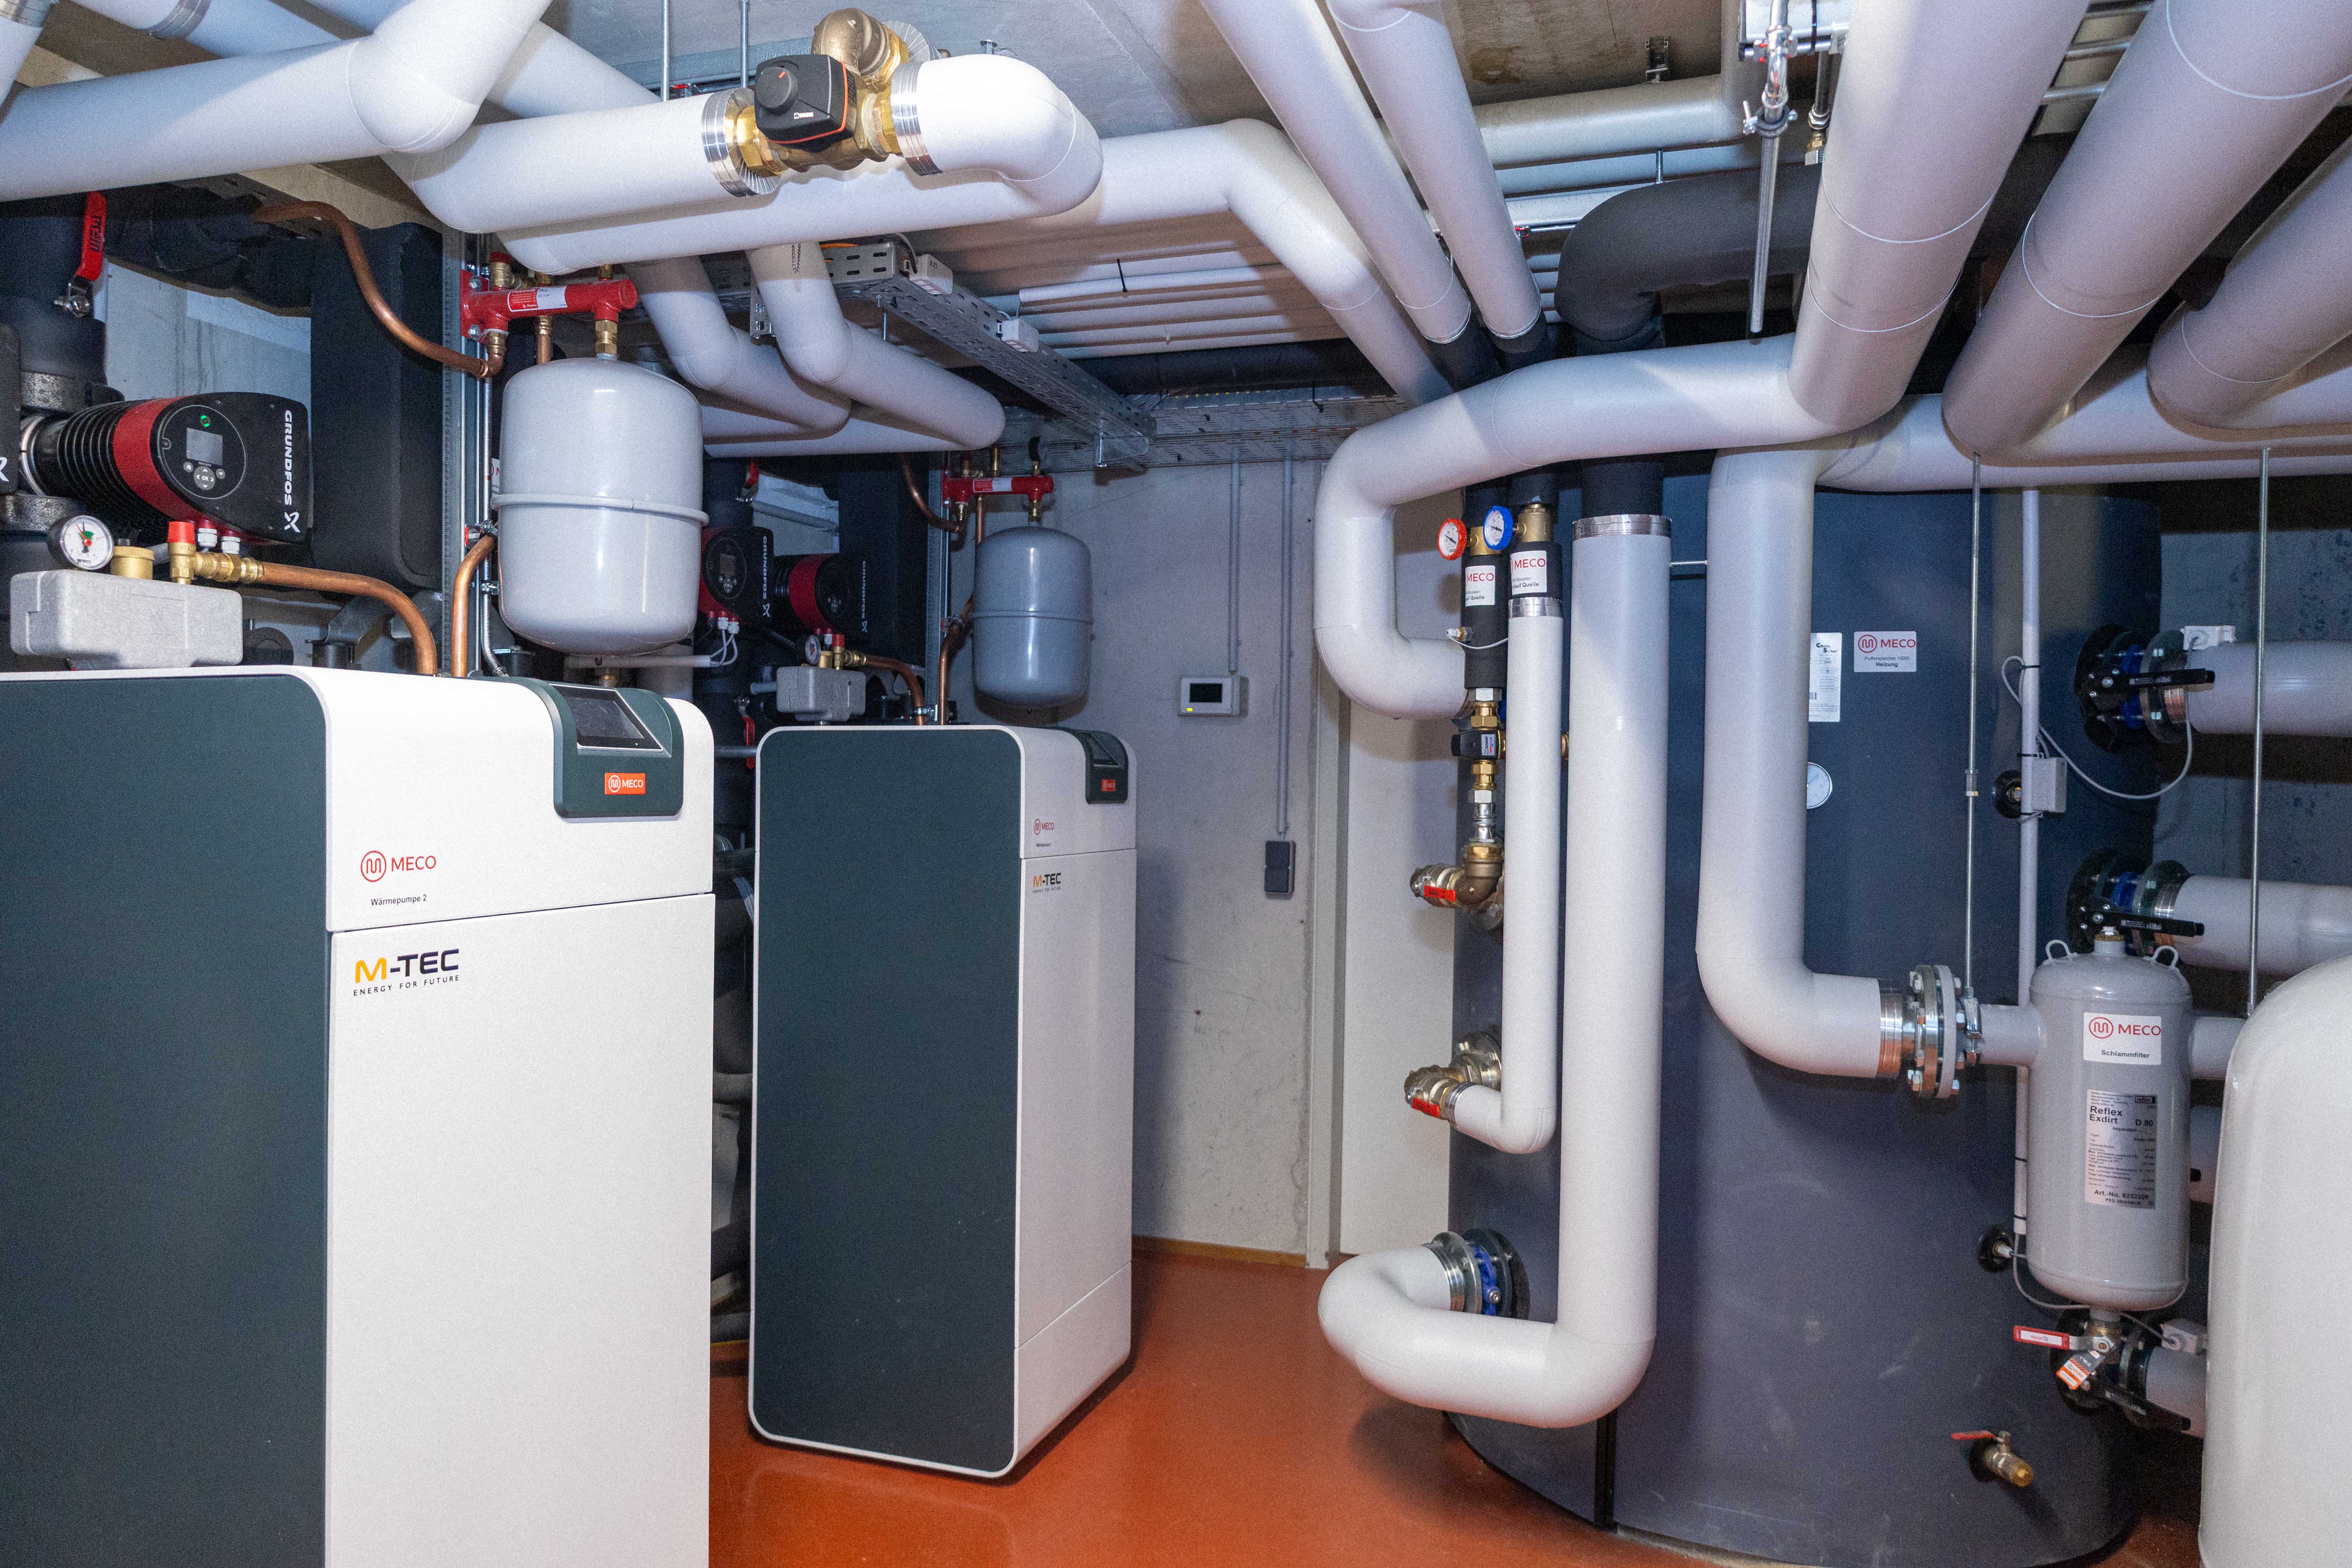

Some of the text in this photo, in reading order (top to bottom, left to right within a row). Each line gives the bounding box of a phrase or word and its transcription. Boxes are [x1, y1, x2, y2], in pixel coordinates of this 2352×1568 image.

[1514, 558, 1546, 569] MECO
[1467, 573, 1494, 583] MECO
[1880, 639, 1916, 648] MECO
[622, 779, 643, 788] MECO
[391, 855, 436, 871] MECO
[1033, 873, 1061, 887] M-TEC
[371, 896, 420, 906] Wärmepumpe
[355, 949, 459, 983] M-TEC
[354, 975, 459, 996] ENERGY FOR FUTURE
[2118, 1024, 2162, 1036] MECO
[2101, 1049, 2149, 1058] Schlammfilter
[2090, 1106, 2122, 1116] Reflex
[2090, 1114, 2118, 1124] Exdirt
[2094, 1189, 2119, 1197] Art.-No.
